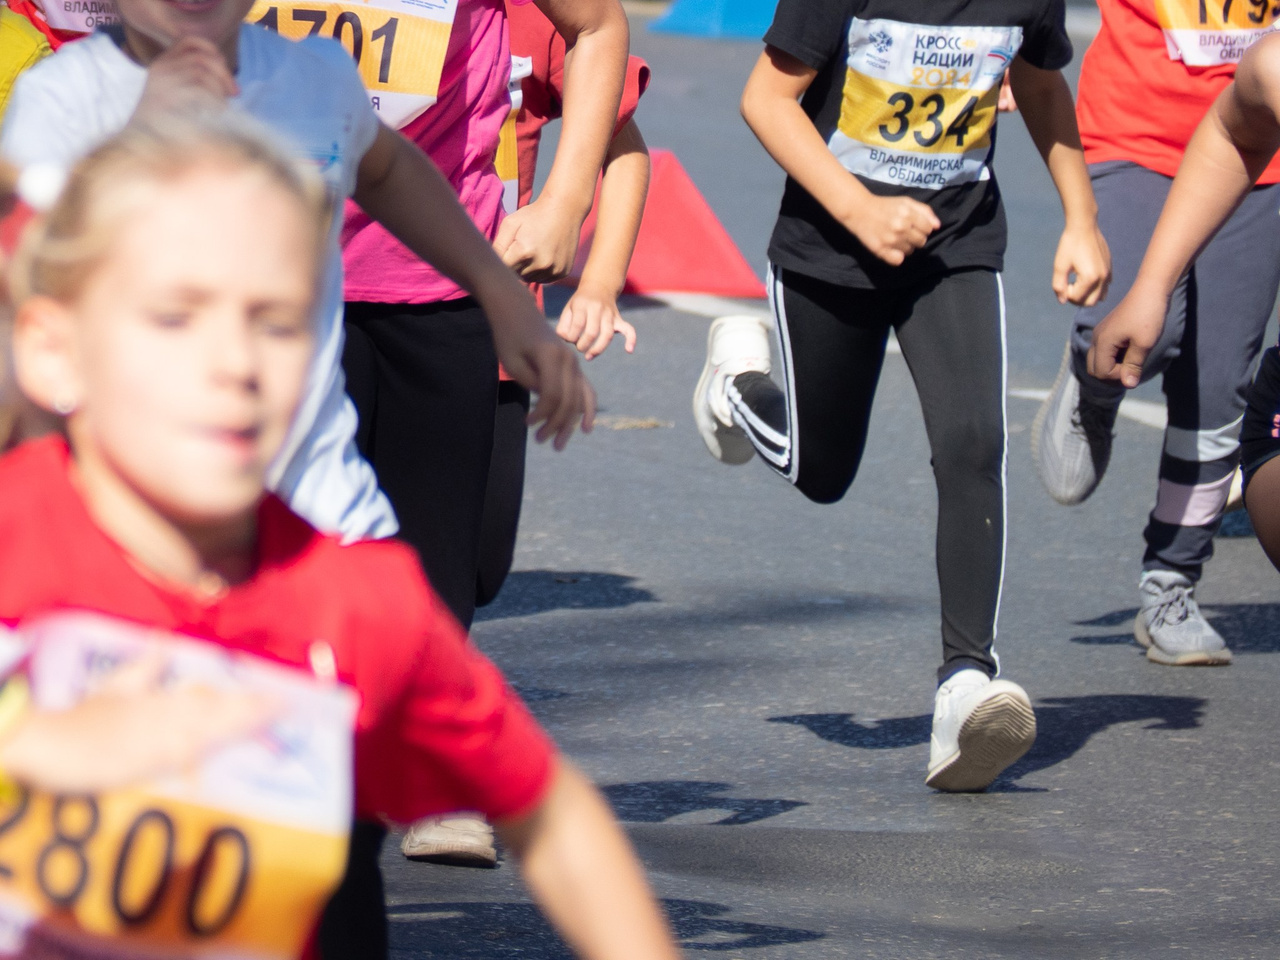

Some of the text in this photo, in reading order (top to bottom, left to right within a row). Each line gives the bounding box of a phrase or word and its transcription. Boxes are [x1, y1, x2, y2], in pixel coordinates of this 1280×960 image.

[64, 0, 120, 16] ВЛАДИМ
[85, 15, 120, 28] ОБЛА
[915, 34, 962, 51] КРОСС
[912, 50, 975, 68] НАЦИИ
[910, 66, 971, 87] 2024
[878, 91, 979, 147] 334
[869, 148, 965, 172] ВЛАДИМИРСКАЯ
[888, 165, 947, 185] ОБЛАСТЬ
